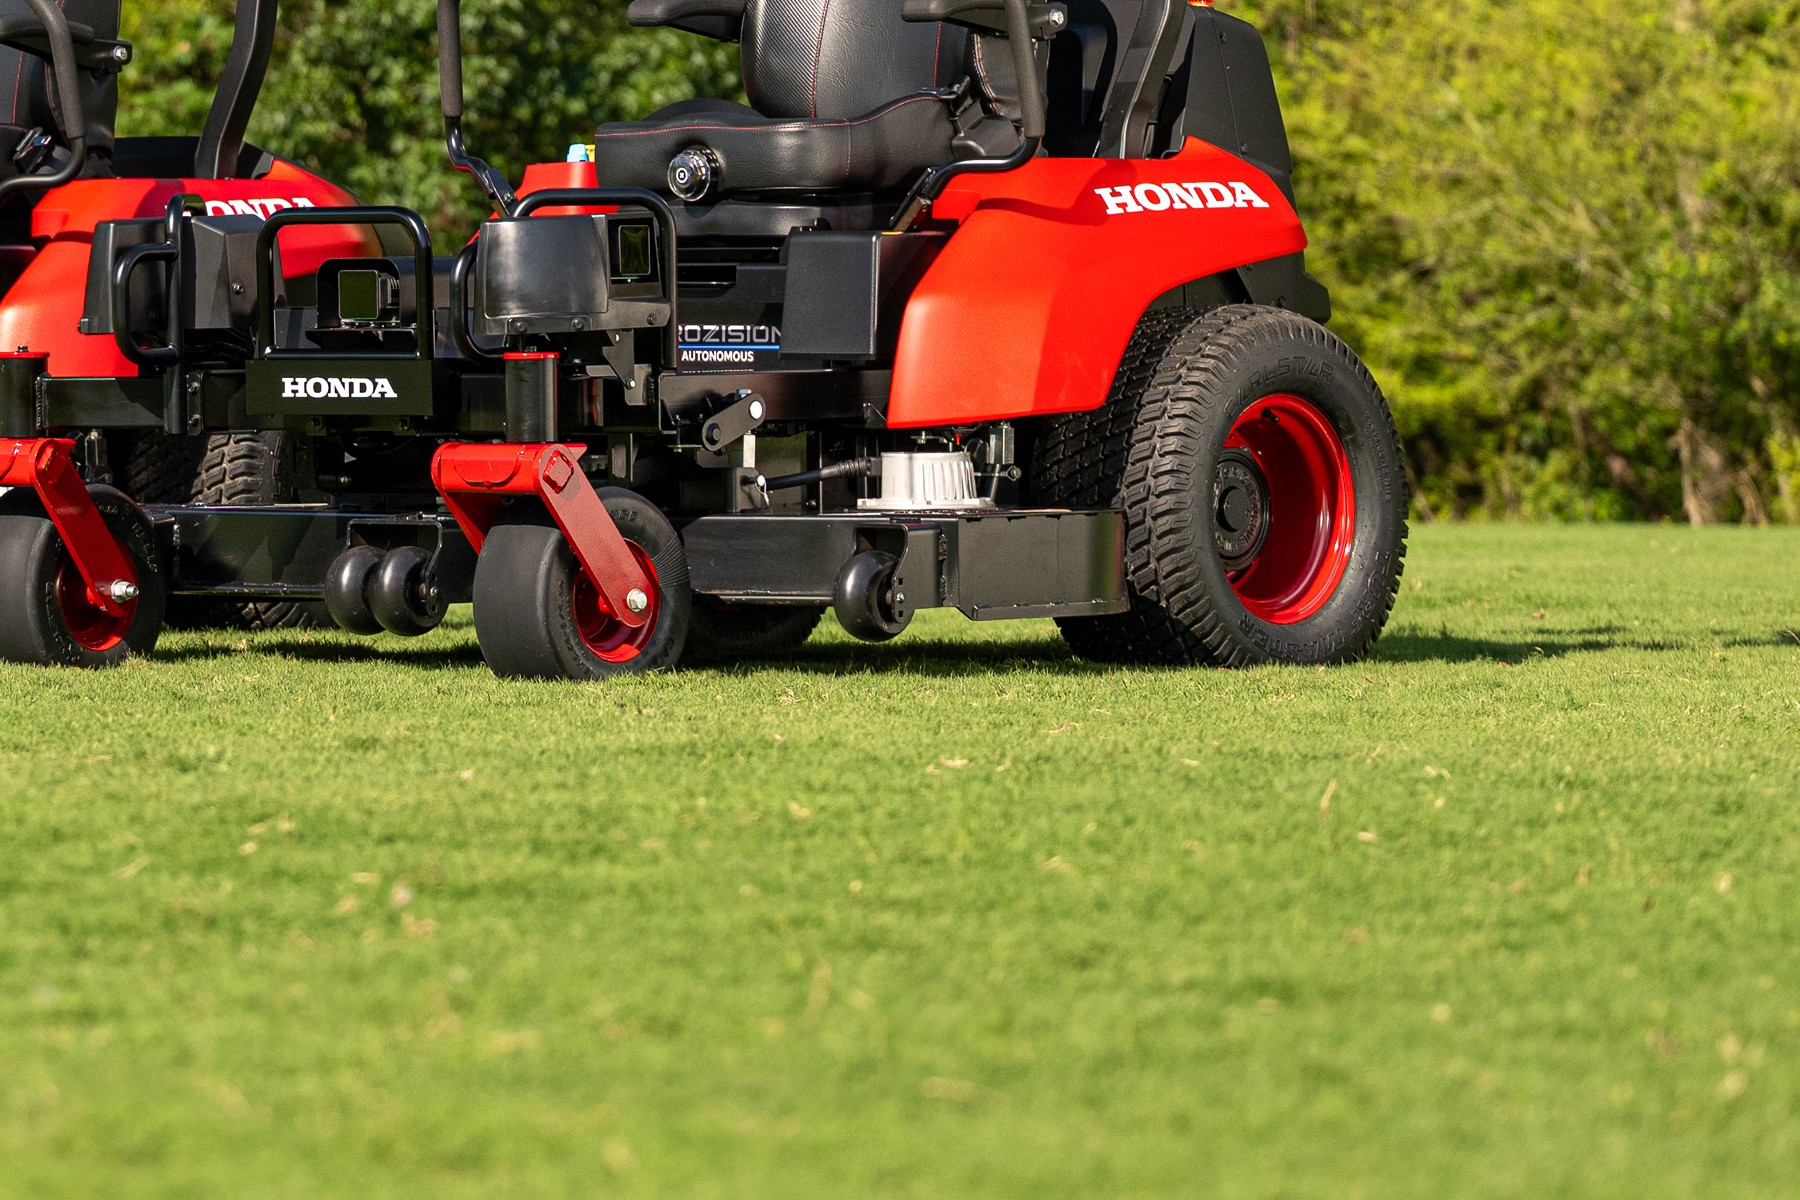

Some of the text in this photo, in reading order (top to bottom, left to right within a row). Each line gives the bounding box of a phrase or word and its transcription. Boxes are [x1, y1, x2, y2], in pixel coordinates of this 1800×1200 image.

[1094, 182, 1270, 215] HONDA
[681, 350, 754, 362] AUTONOMOUS
[281, 377, 398, 398] HONDA
[1224, 356, 1335, 421] CARLSTAR
[1237, 612, 1346, 660] MASTER
